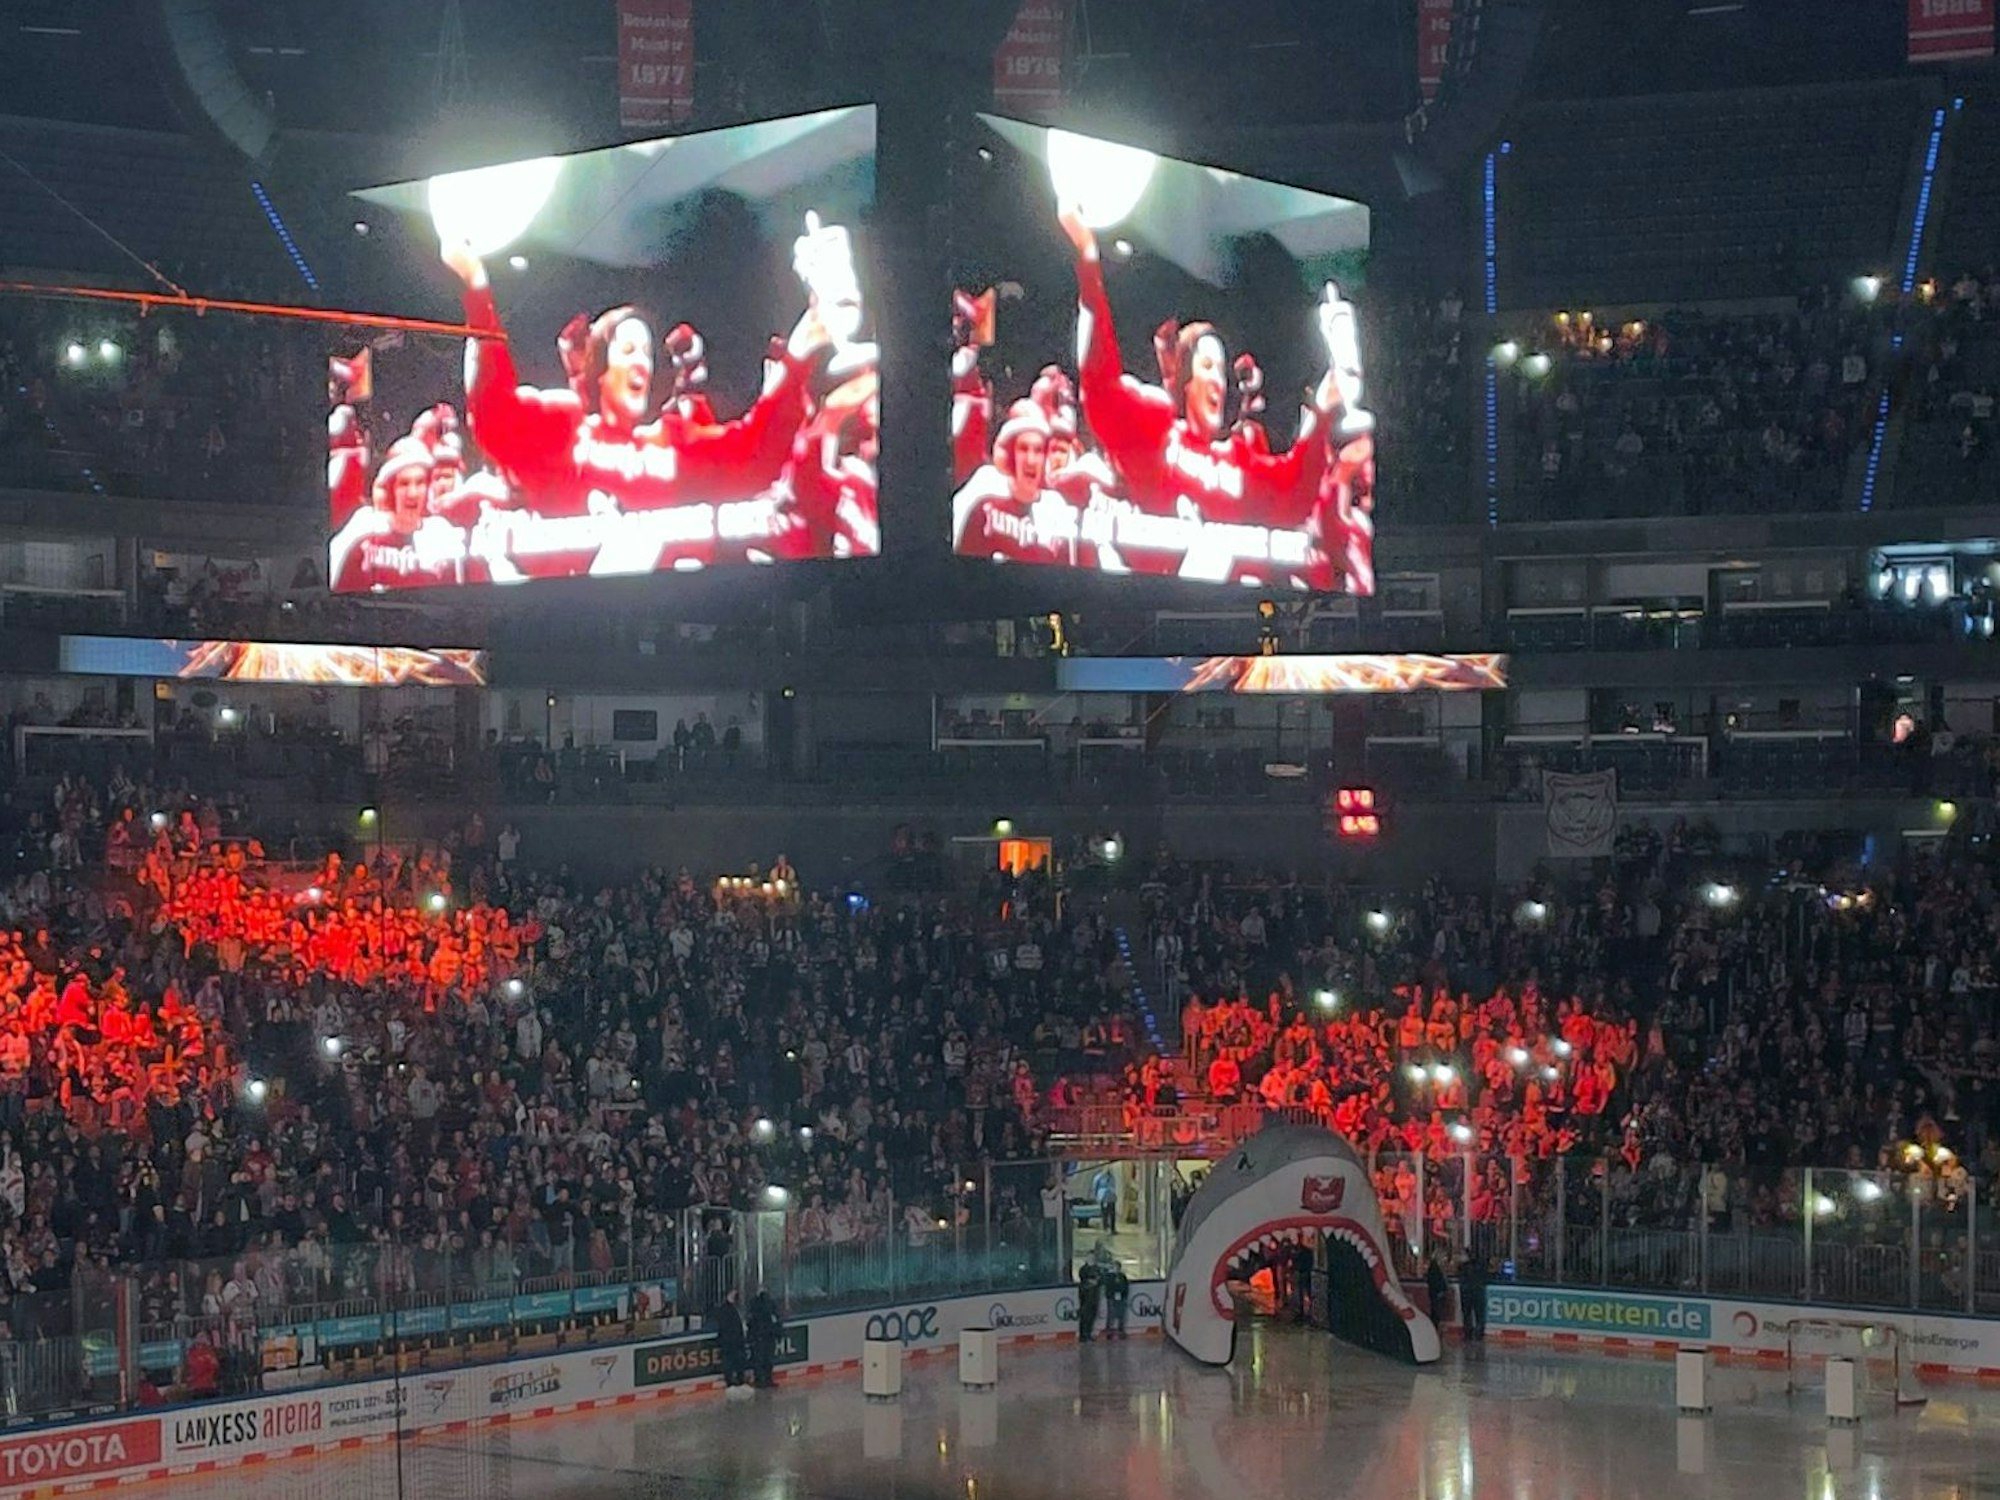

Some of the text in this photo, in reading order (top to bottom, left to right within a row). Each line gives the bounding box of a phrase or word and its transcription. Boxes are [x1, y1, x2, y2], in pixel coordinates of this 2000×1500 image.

[1488, 1296, 1703, 1331] sportwetten.de
[176, 1410, 257, 1446] LANXESS
[263, 1400, 322, 1439] arena
[1, 1433, 126, 1478] TOYOTA
